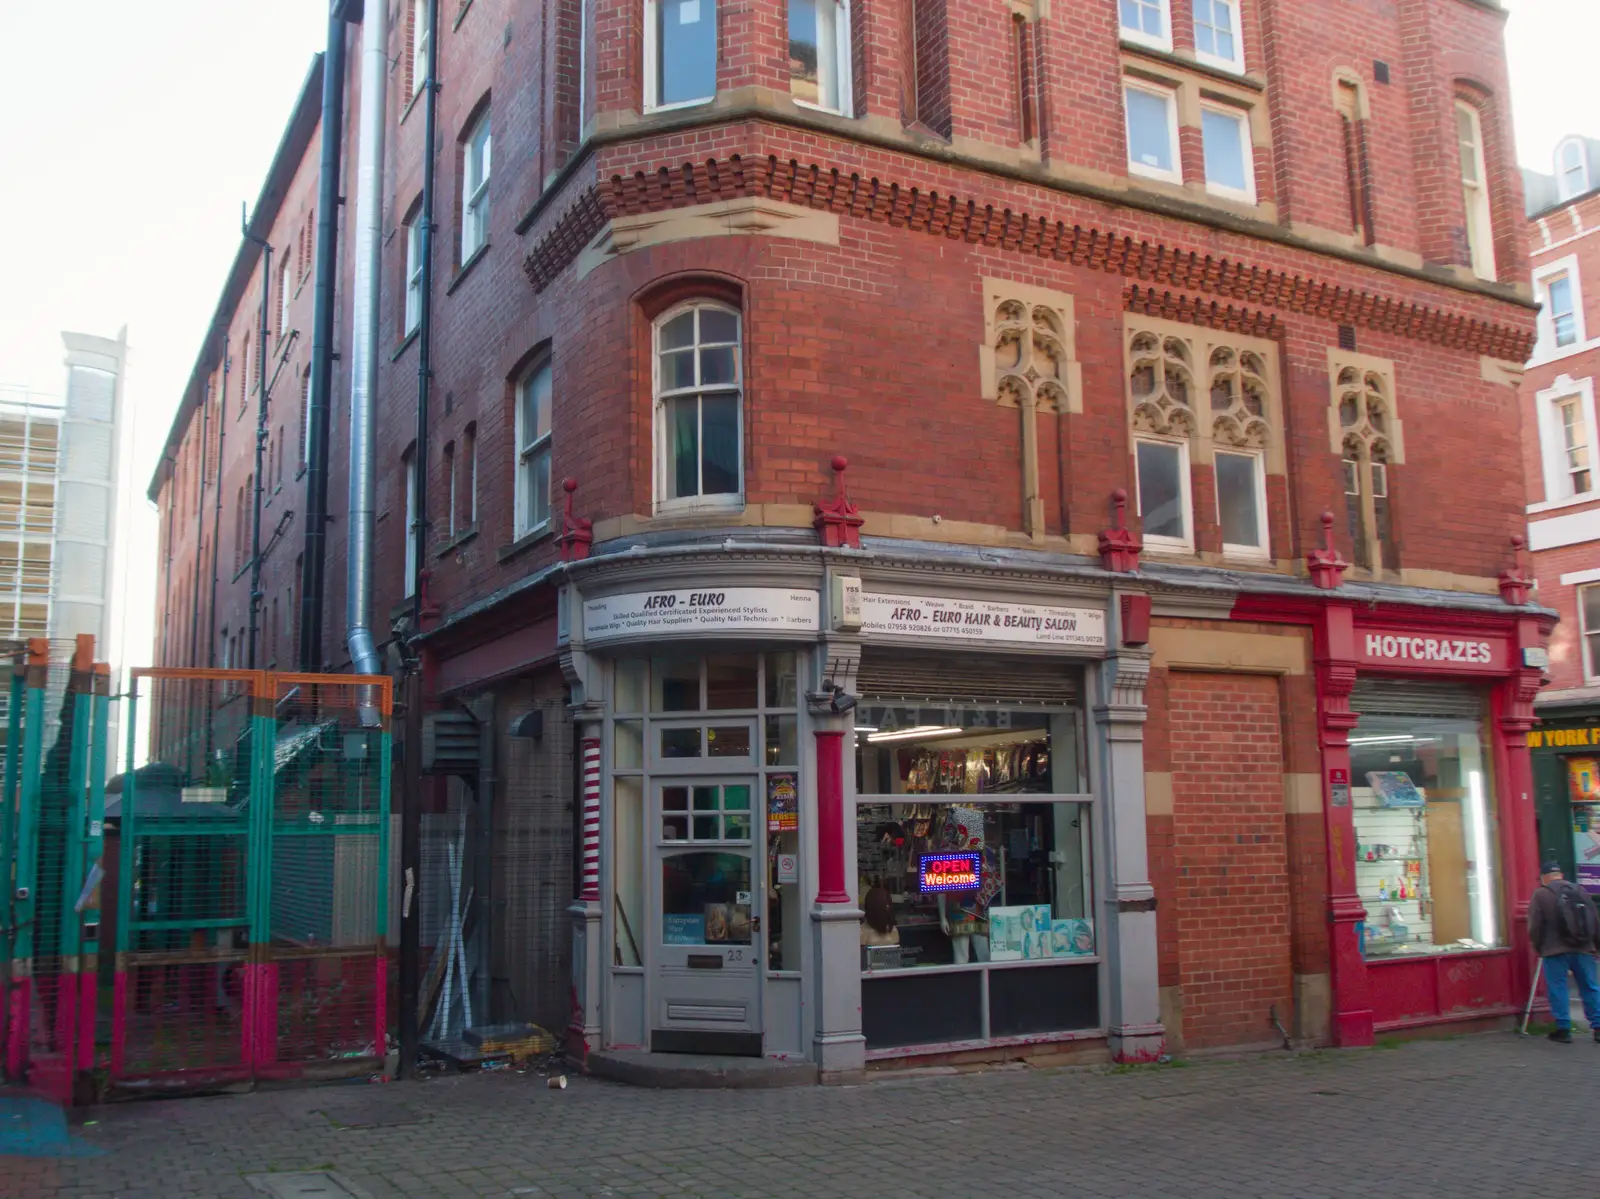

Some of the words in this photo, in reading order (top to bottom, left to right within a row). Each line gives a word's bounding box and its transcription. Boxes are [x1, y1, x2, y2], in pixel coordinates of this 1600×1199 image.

[644, 594, 676, 610] AFRO
[688, 592, 725, 606] EURO
[790, 594, 812, 602] Henna
[878, 597, 911, 606] Extensions
[924, 600, 945, 608] Weave
[958, 602, 975, 610] Braid
[987, 605, 1009, 613] Barbers
[630, 610, 658, 620] Qualified
[658, 608, 697, 617] Certificated
[698, 606, 741, 615] Experienced
[742, 606, 768, 614] Stylists
[891, 608, 922, 622] AFRO
[932, 610, 962, 624] EURO
[964, 612, 992, 626] HAIR
[993, 614, 1001, 627] &
[1003, 614, 1042, 631] BEAUTY
[1044, 618, 1077, 632] SALON
[626, 619, 647, 628] Quality
[662, 616, 693, 626] Suppliers
[700, 616, 726, 624] Quality
[860, 621, 886, 630] Mobiles
[888, 623, 908, 631] 07958
[908, 624, 932, 632] 920826
[1365, 634, 1492, 664] HOTCRAZES
[1544, 728, 1589, 747] YORK
[932, 860, 970, 873] OPEN
[924, 872, 976, 886] Welcome
[728, 950, 743, 962] 23
